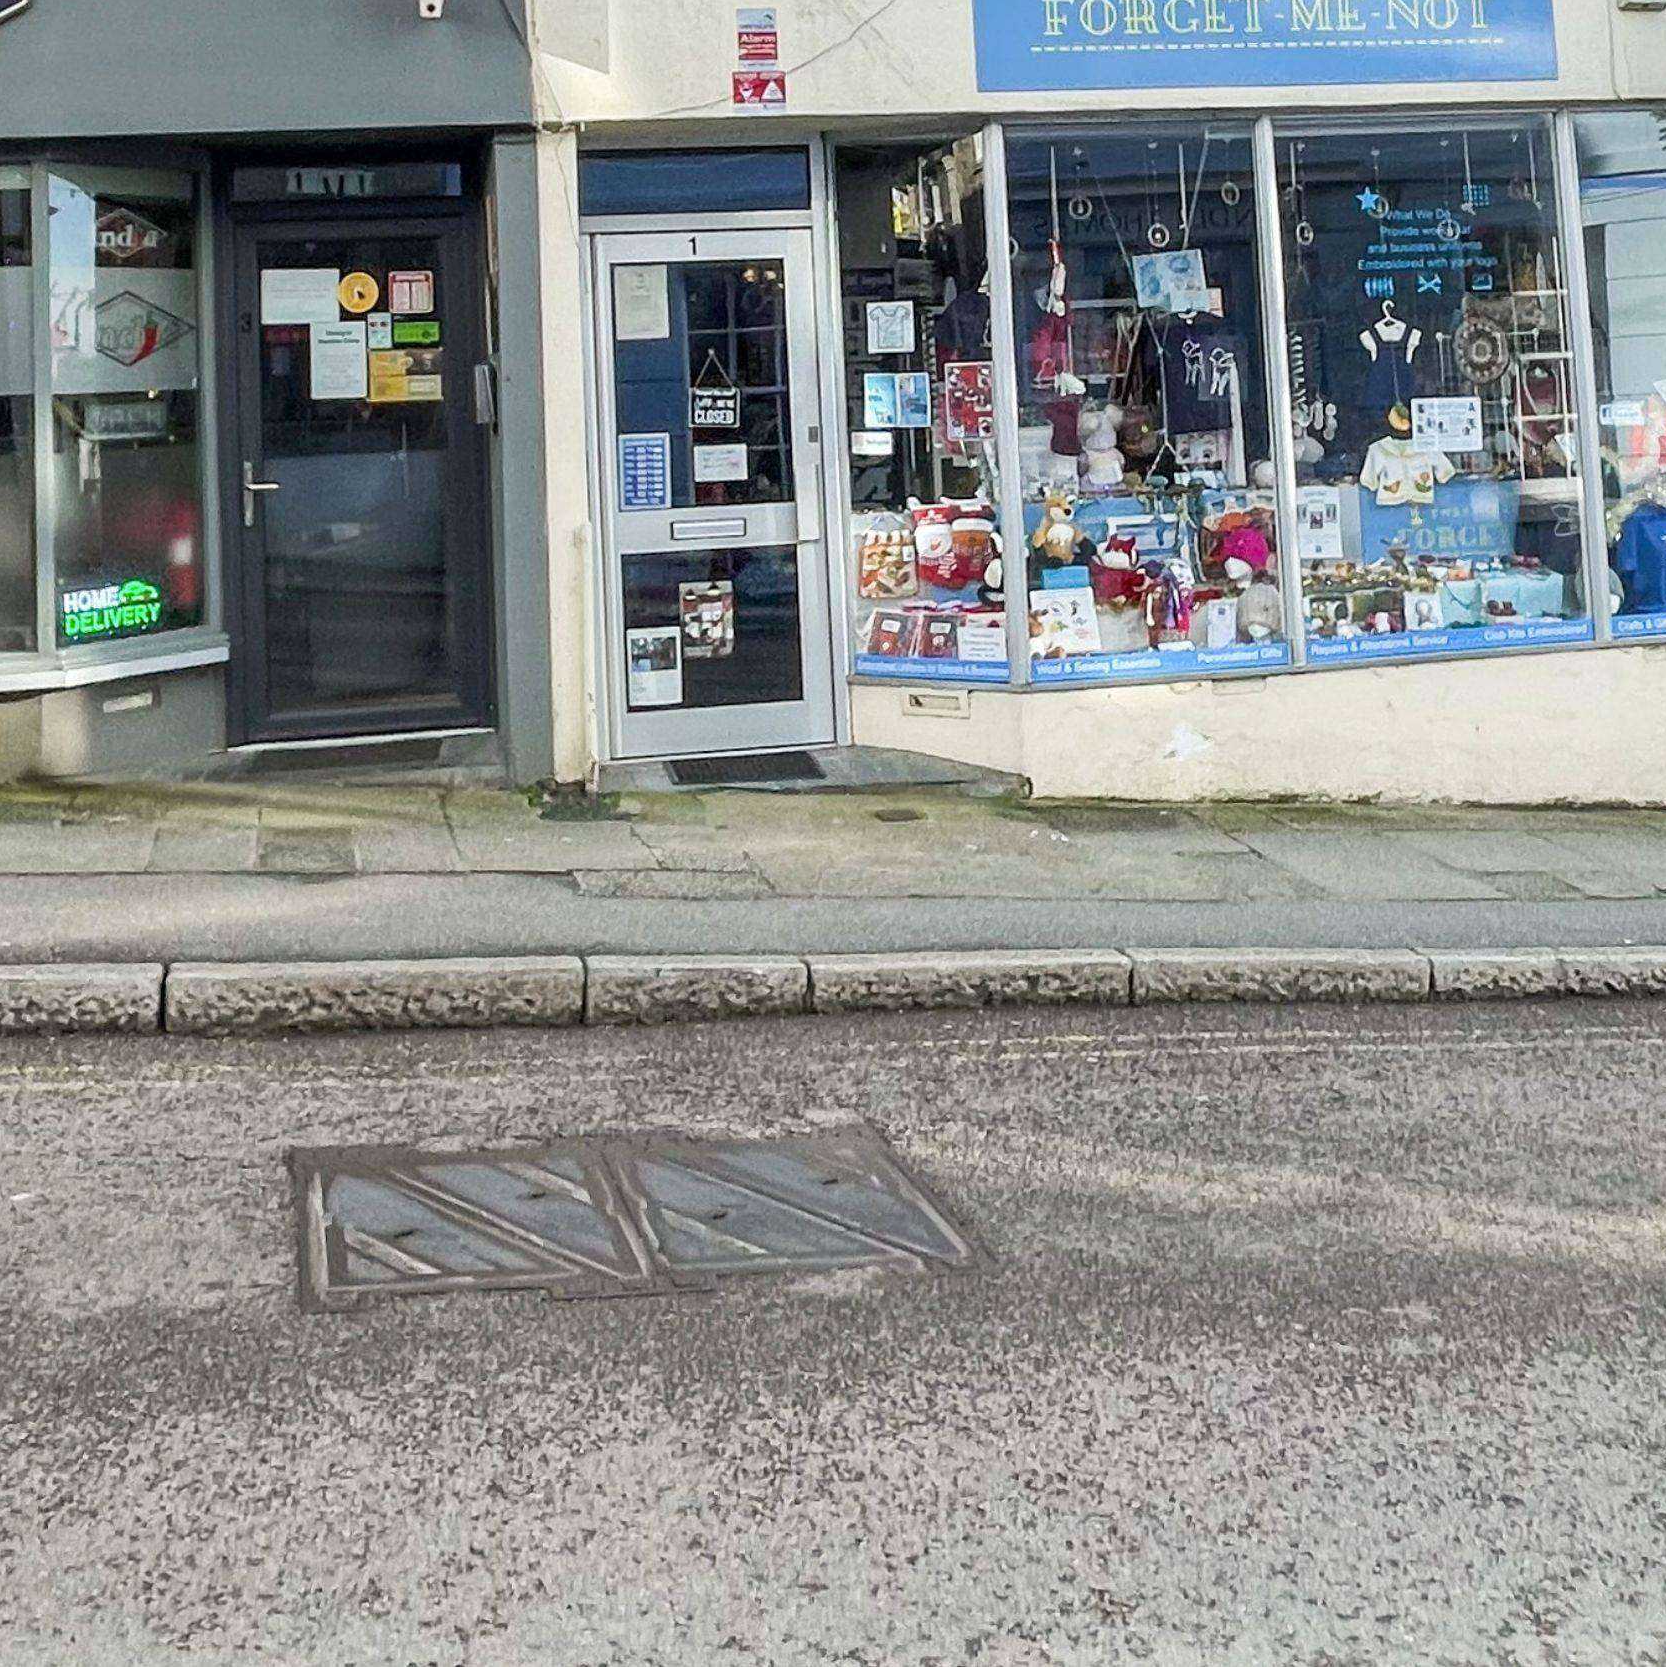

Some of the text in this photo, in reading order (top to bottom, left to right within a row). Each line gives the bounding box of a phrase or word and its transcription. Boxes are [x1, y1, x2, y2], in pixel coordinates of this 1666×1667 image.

[95, 223, 158, 250] ndia
[688, 236, 697, 255] 1
[63, 585, 119, 614] HOME
[65, 602, 161, 636] DELIVERY
